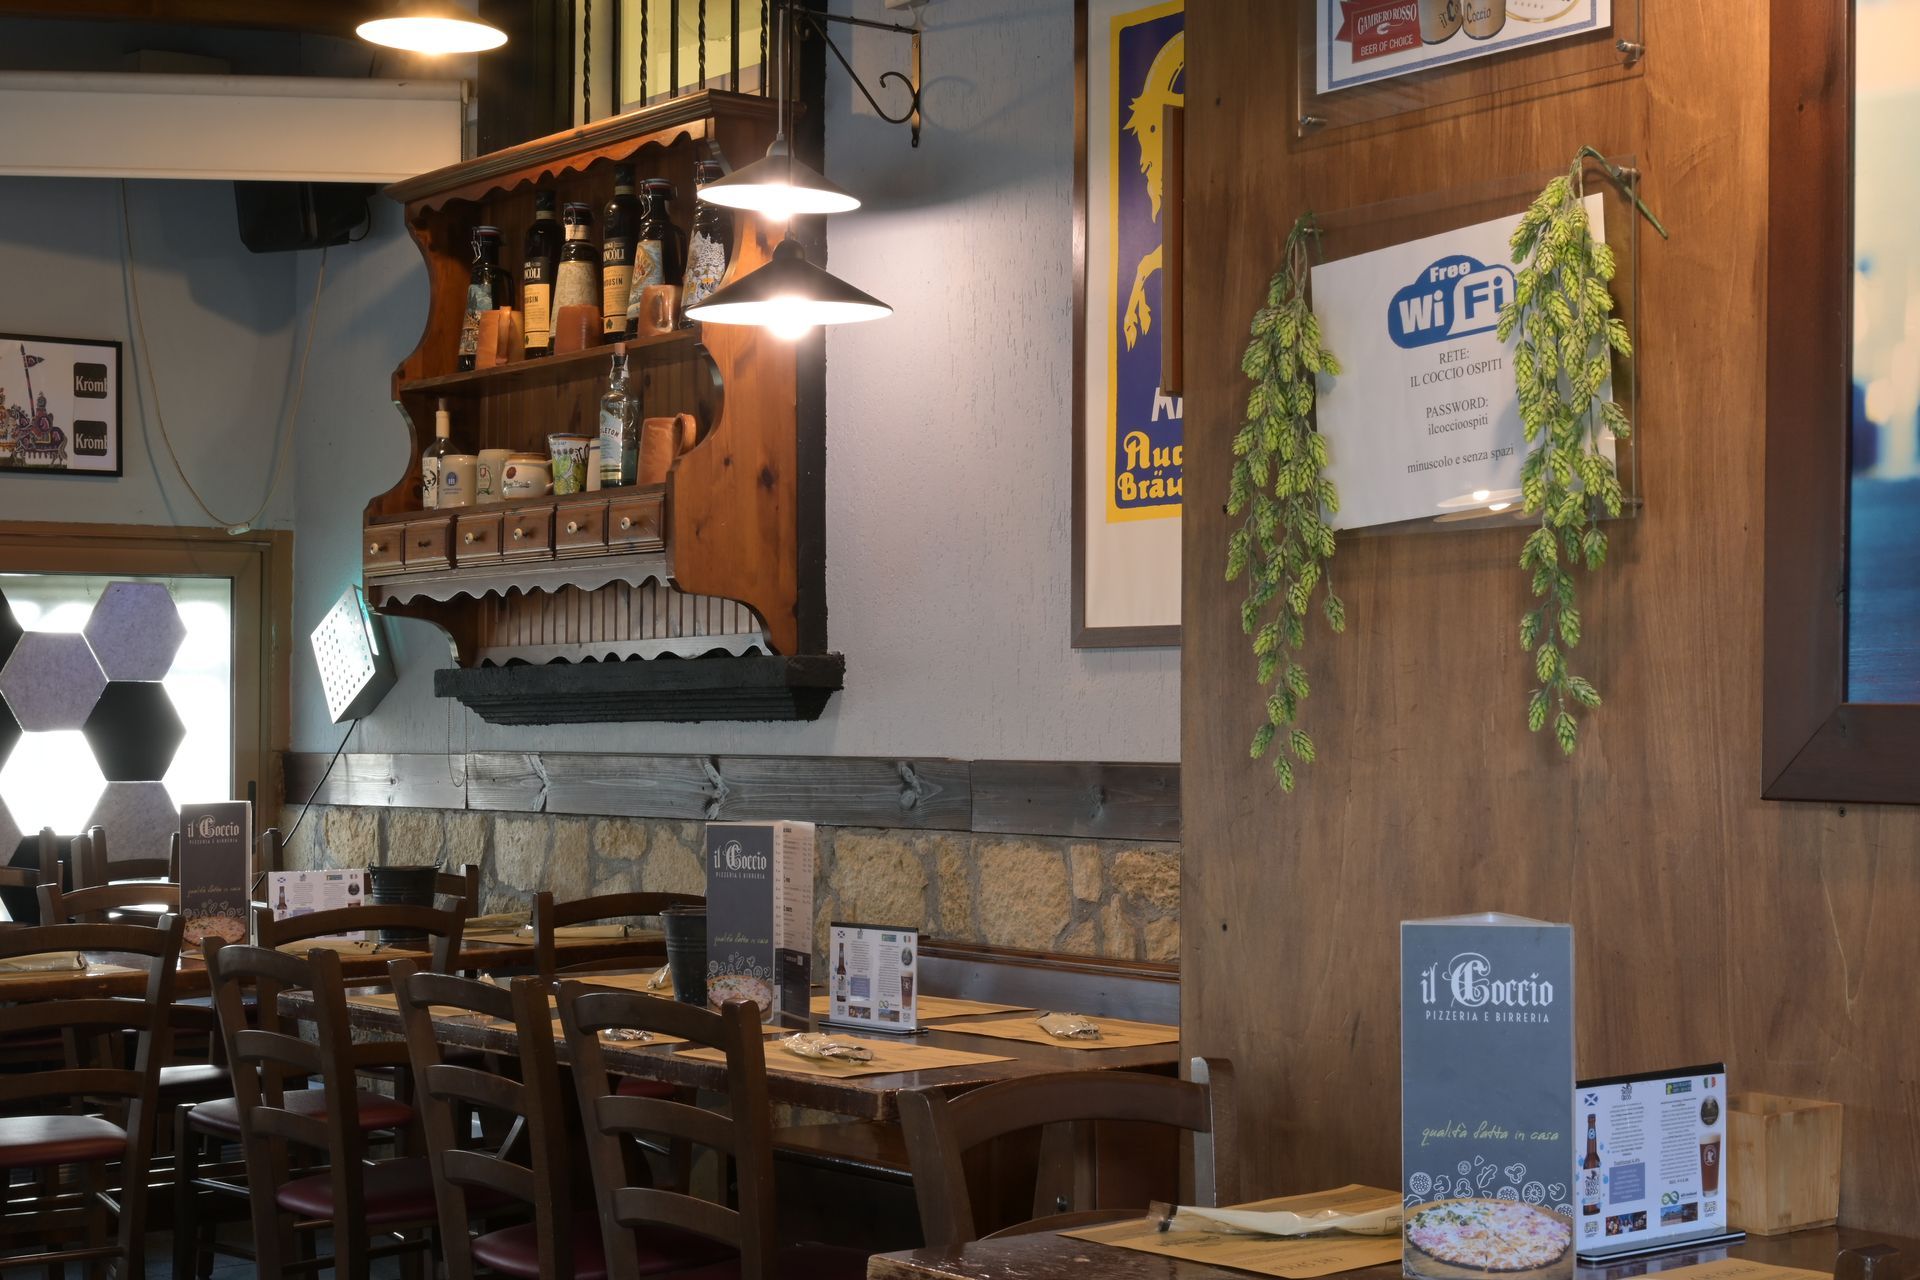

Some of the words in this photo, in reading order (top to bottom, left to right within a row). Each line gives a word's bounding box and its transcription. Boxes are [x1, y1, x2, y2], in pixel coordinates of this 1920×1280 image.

[1358, 9, 1392, 35] GAMBERO
[1392, 3, 1417, 22] ROSSO
[1360, 44, 1378, 56] BEER
[1379, 40, 1388, 51] OF
[1390, 34, 1414, 48] CHOICE
[1430, 262, 1471, 283] Free
[1440, 348, 1470, 364] RETE:
[1410, 376, 1420, 388] IL
[1422, 366, 1464, 385] COCCIO
[1466, 358, 1502, 376] OSPITI
[1426, 396, 1488, 418] PASSWORD:
[1428, 412, 1488, 436] ilcoccioospiti
[1408, 456, 1454, 474] minuscolo
[1456, 456, 1462, 465] e
[1462, 451, 1488, 464] senza
[1490, 443, 1514, 461] spazi
[187, 818, 195, 838] il
[195, 814, 240, 838] Coccio
[713, 844, 722, 869] il
[722, 840, 768, 871] Coccio
[1420, 961, 1438, 1004] il
[1441, 952, 1554, 1008] Coccio
[1426, 1010, 1478, 1022] PIZZERIA
[1484, 1012, 1489, 1022] E
[1495, 1012, 1550, 1024] BIRRERIA
[1421, 1119, 1468, 1147] qualità
[1472, 1120, 1509, 1140] fatta
[1514, 1130, 1525, 1141] in
[1530, 1130, 1560, 1141] casa
